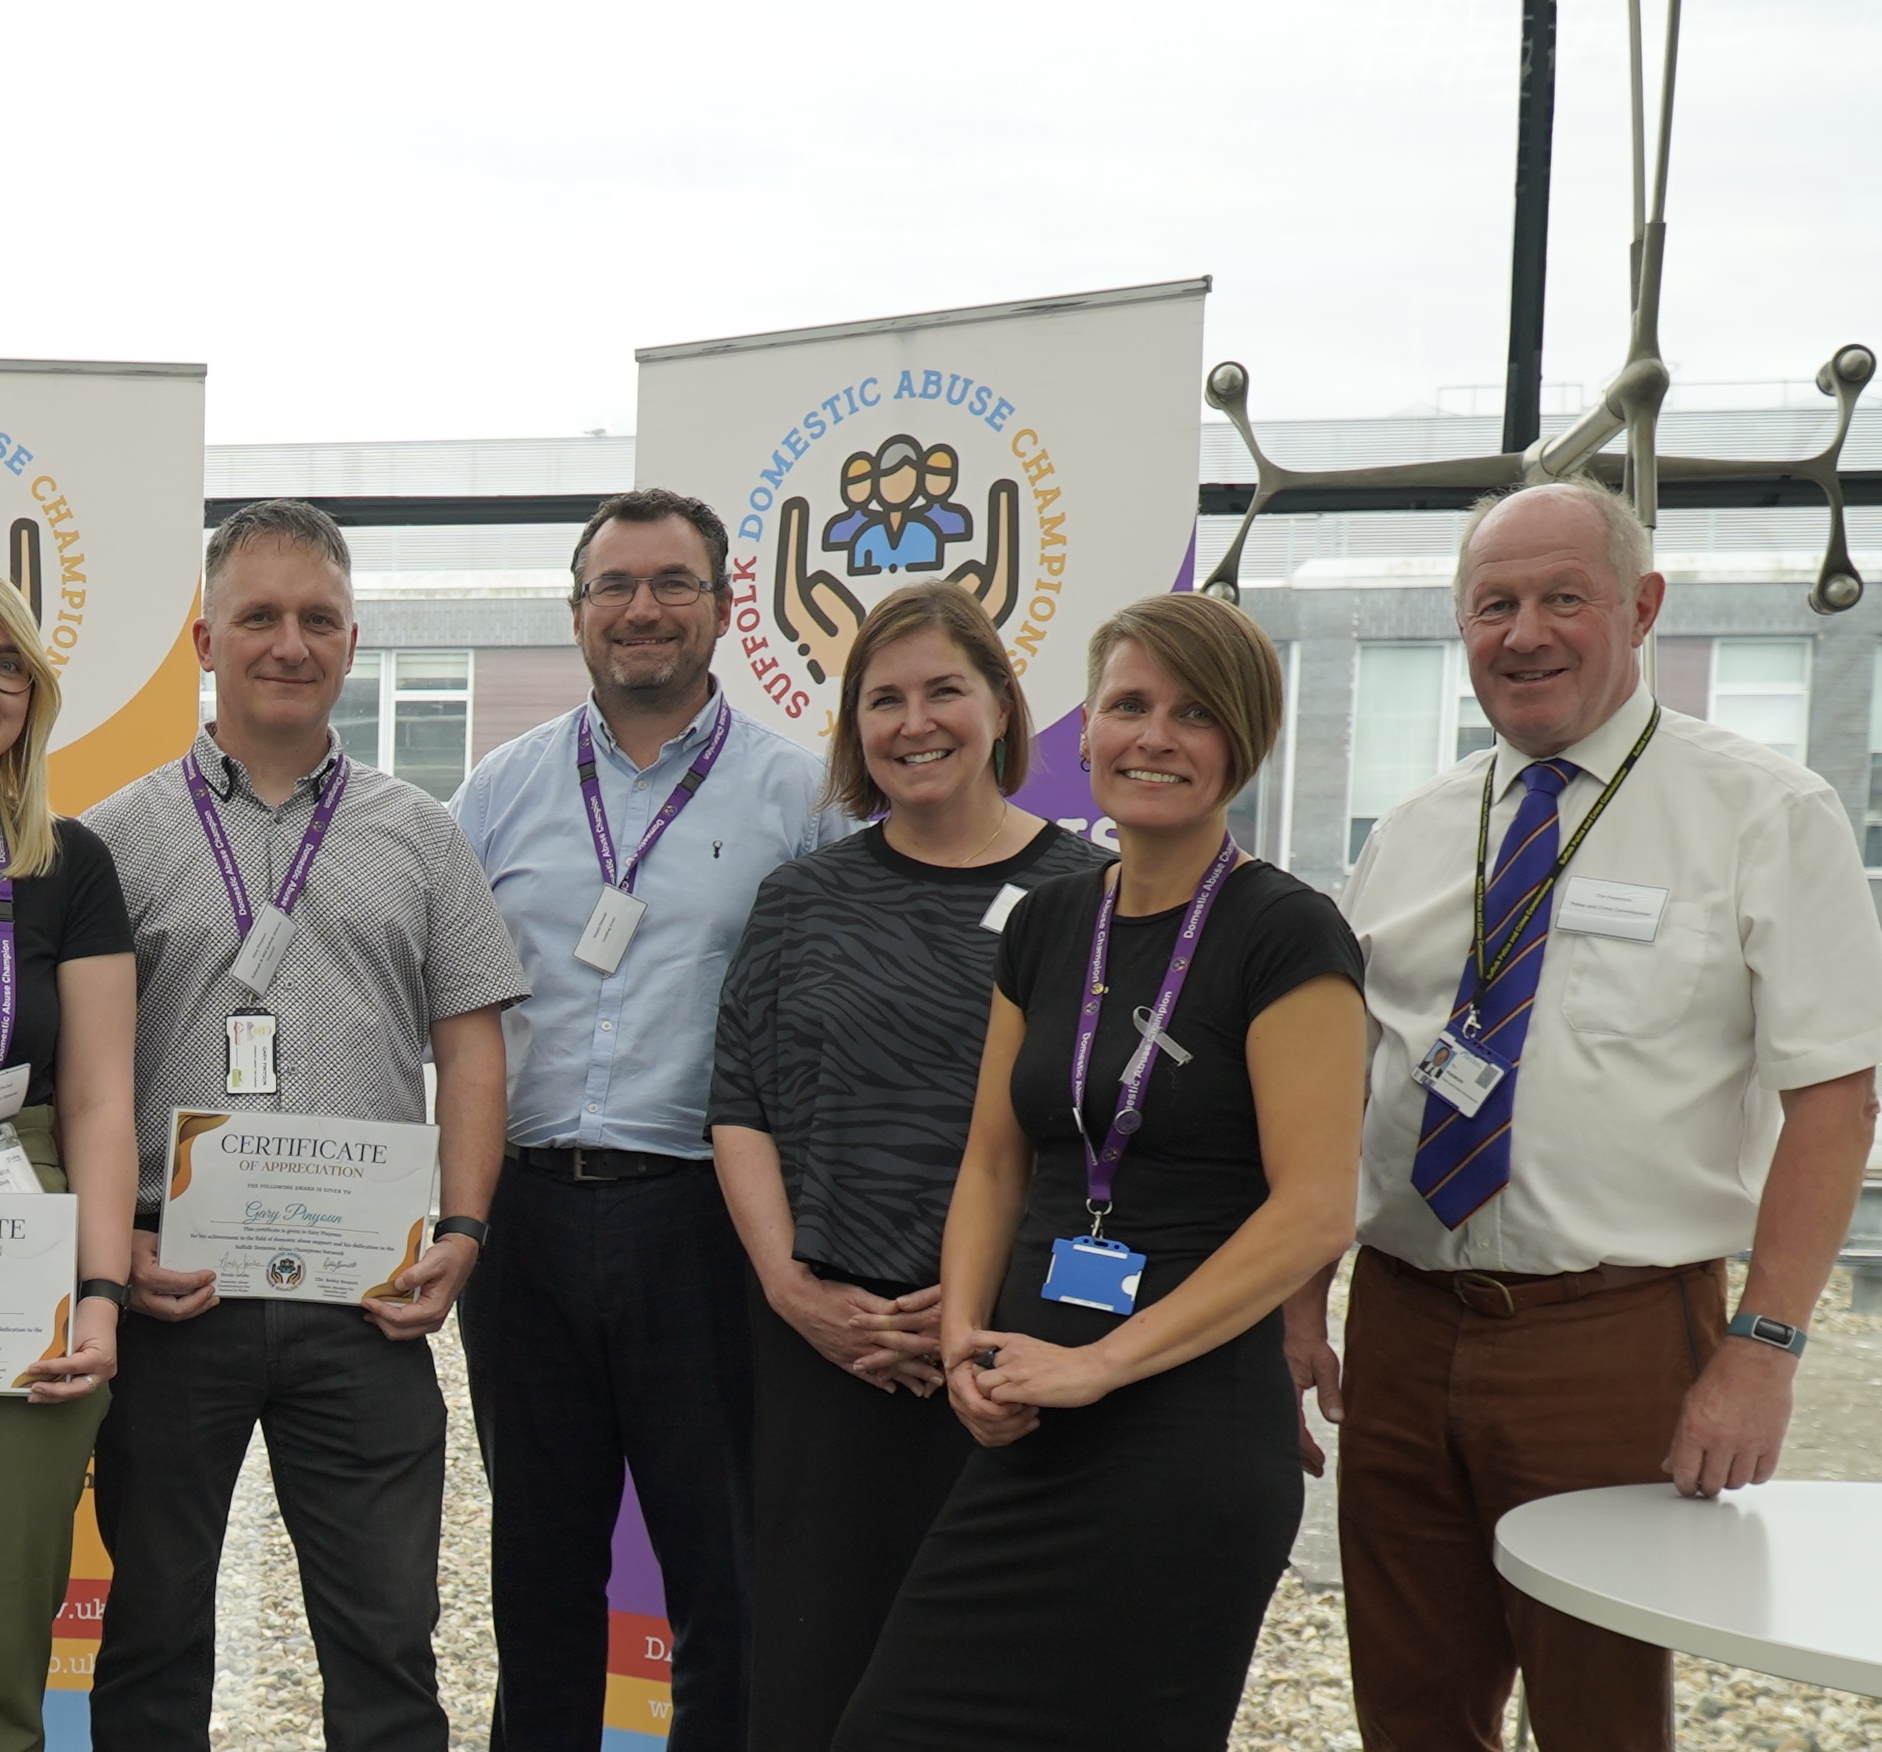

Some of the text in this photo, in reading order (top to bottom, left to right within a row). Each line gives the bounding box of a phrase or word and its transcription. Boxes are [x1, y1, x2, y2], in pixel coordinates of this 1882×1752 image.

[893, 369, 1016, 433] ABUSE
[738, 376, 882, 543] DOMESTIC
[733, 555, 810, 719] SUFFOLK
[220, 849, 234, 876] Abuse
[229, 876, 247, 916] Domestic
[1183, 891, 1210, 939] Domestic
[1202, 863, 1226, 892] Abuse
[1, 939, 12, 984] Champion
[1091, 930, 1106, 982] Champion
[1, 984, 12, 1015] Abuse
[221, 1133, 388, 1164] CERTIFICATE
[239, 1159, 364, 1179] OF APPRECIATION
[243, 1200, 281, 1225] Gary
